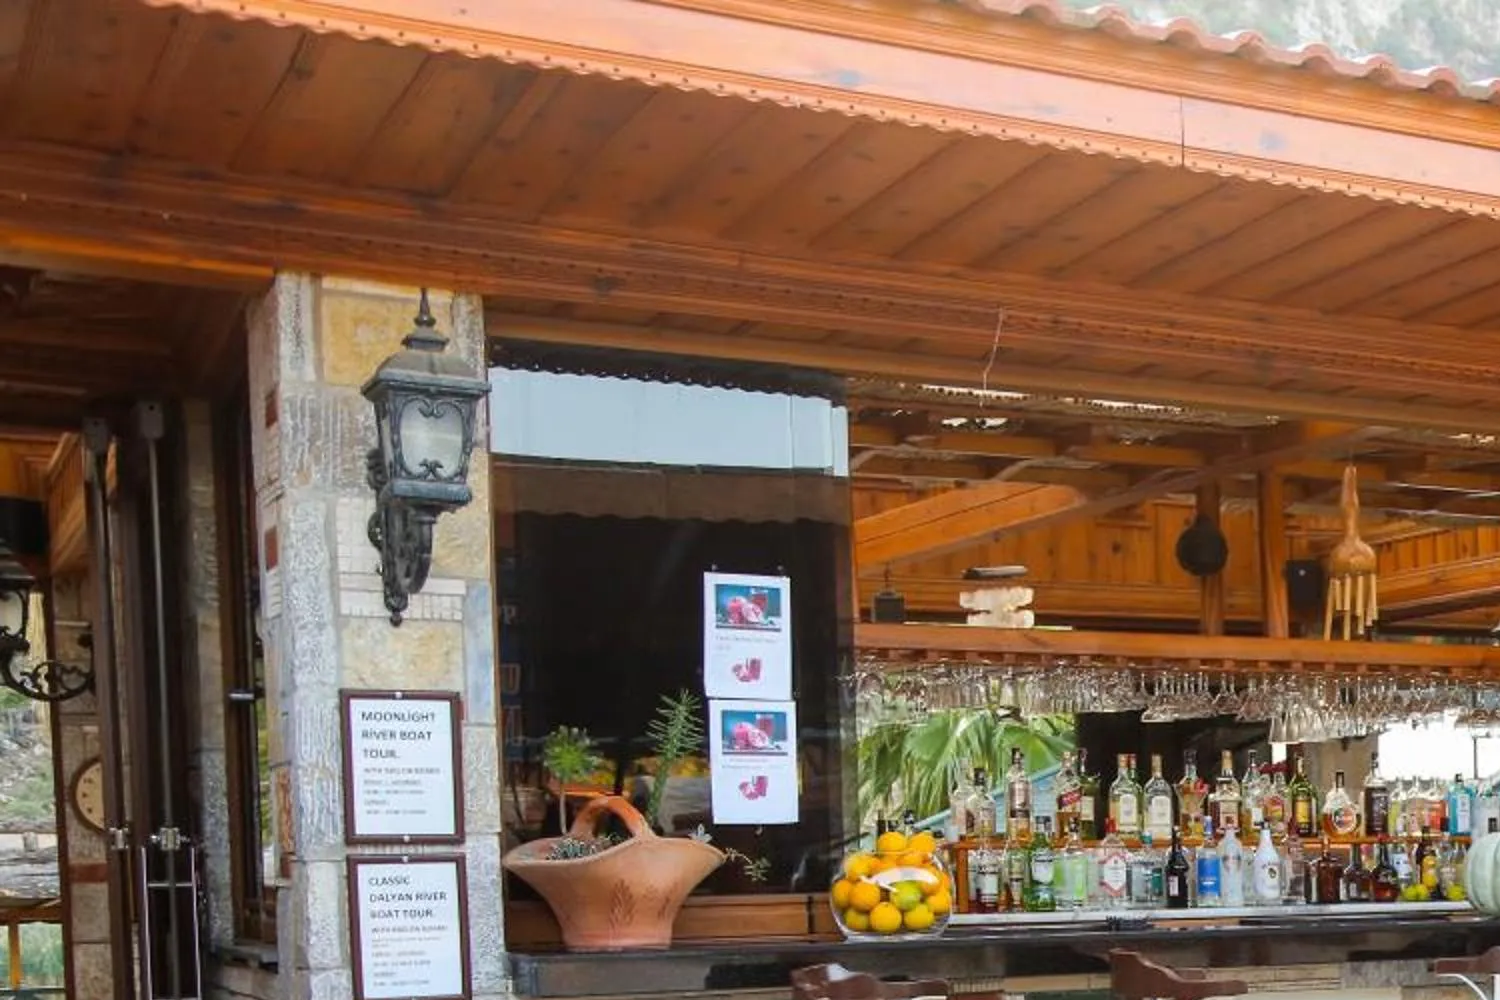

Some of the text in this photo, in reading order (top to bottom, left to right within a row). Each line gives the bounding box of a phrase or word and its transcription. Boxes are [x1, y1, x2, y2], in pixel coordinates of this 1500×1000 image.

[399, 731, 432, 740] BOAT
[370, 893, 412, 902] DALYAN
[370, 910, 400, 919] BOAT
